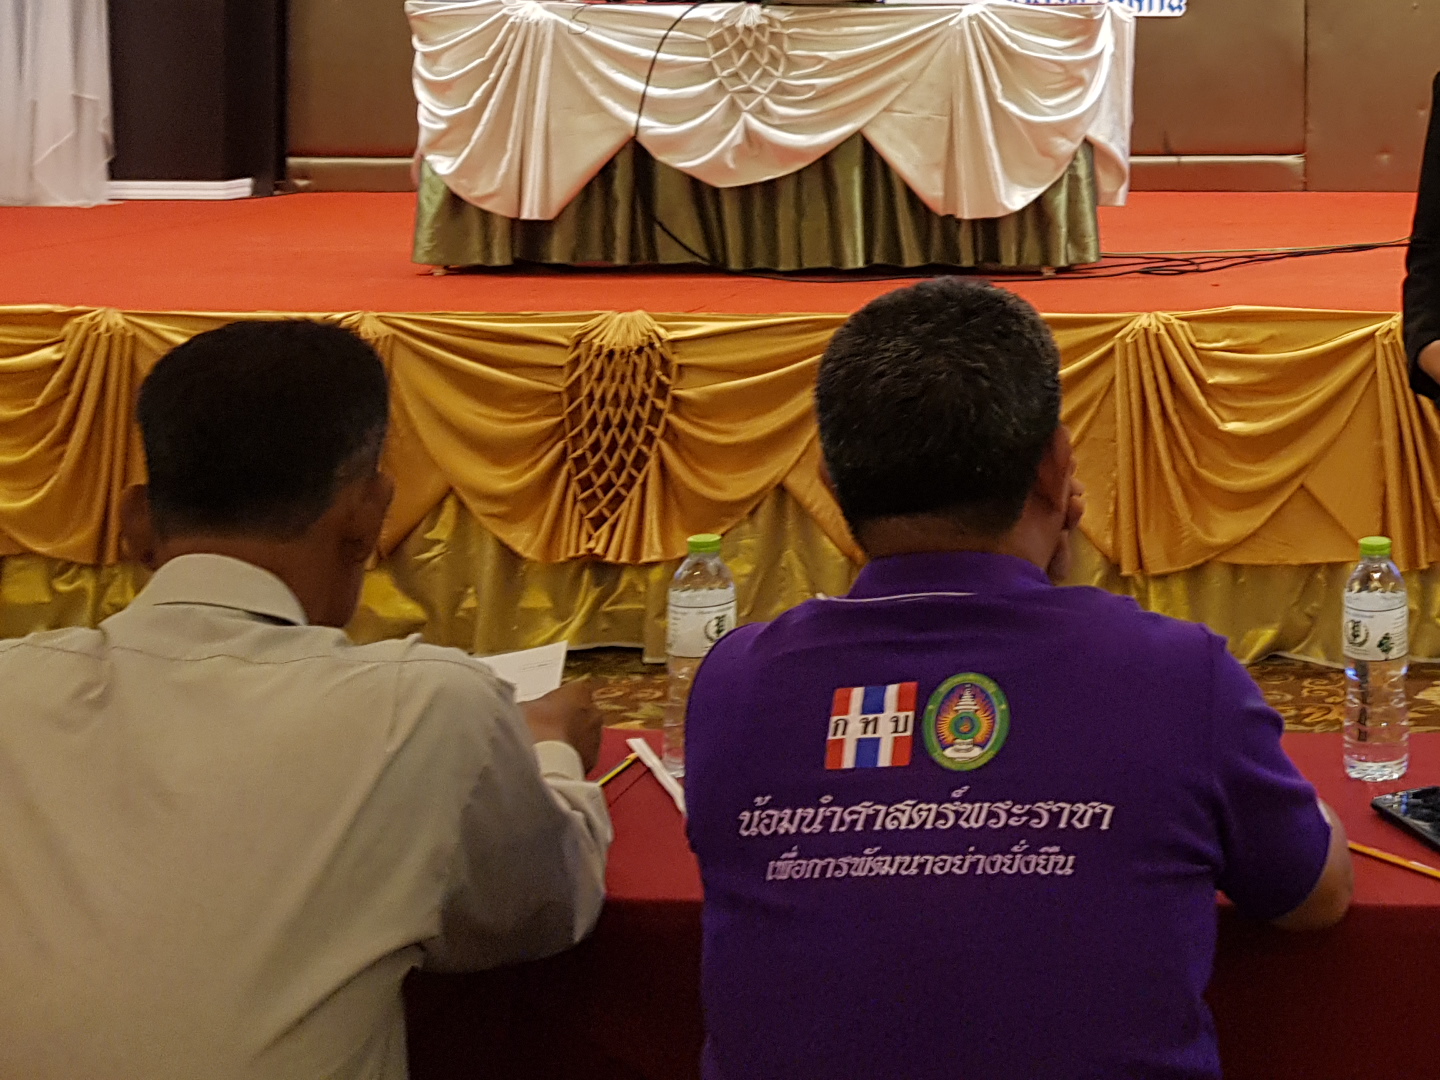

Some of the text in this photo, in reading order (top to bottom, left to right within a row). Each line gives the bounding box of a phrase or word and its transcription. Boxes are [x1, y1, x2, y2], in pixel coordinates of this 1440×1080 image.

[832, 714, 910, 738] กทบ
[739, 786, 1115, 837] น้อมนำศาสตร์พระราชา
[765, 840, 1076, 881] เพื่อการพัฒนาอย่างยั่งยืน
